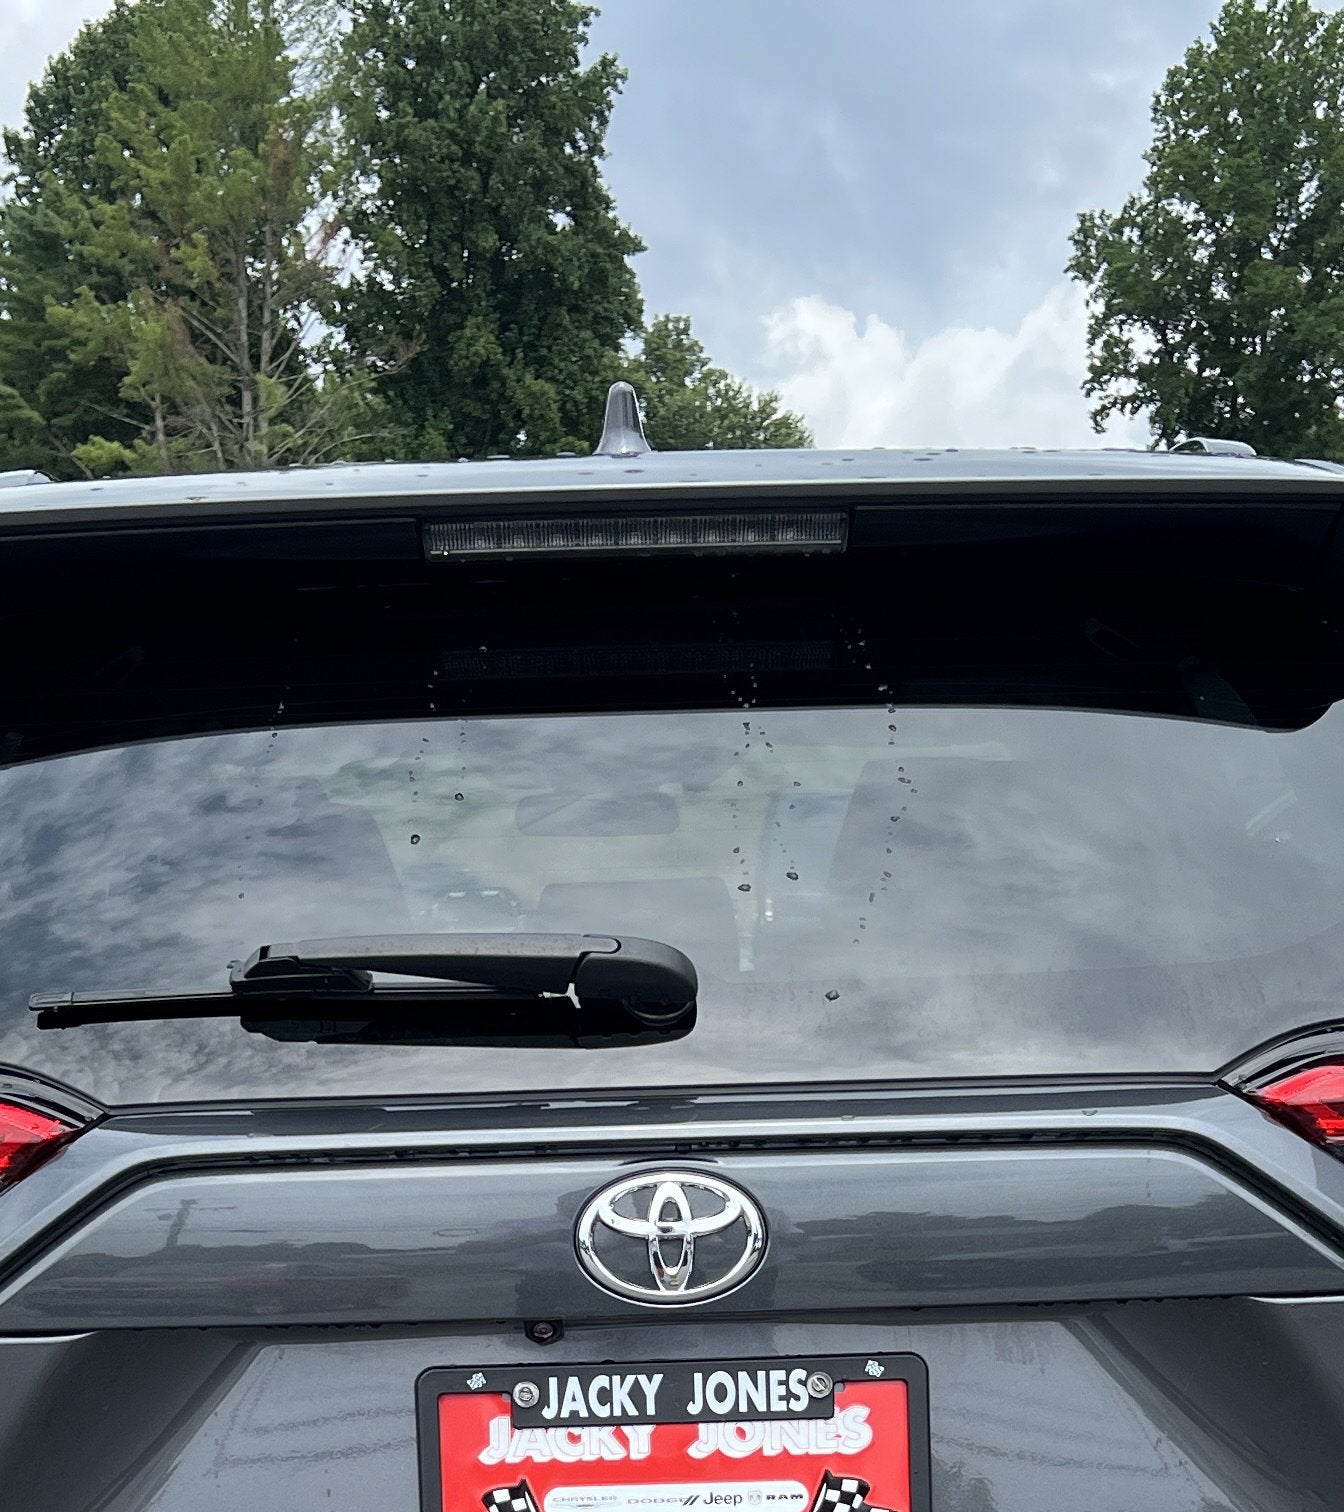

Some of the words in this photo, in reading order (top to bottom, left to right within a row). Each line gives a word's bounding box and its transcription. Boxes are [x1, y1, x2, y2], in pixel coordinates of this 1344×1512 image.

[541, 1372, 664, 1419] JACKY
[686, 1368, 810, 1415] JONES
[477, 1414, 656, 1465] JACKY
[687, 1404, 873, 1459] JONES
[702, 1491, 743, 1507] Jeep
[765, 1493, 804, 1501] RAM
